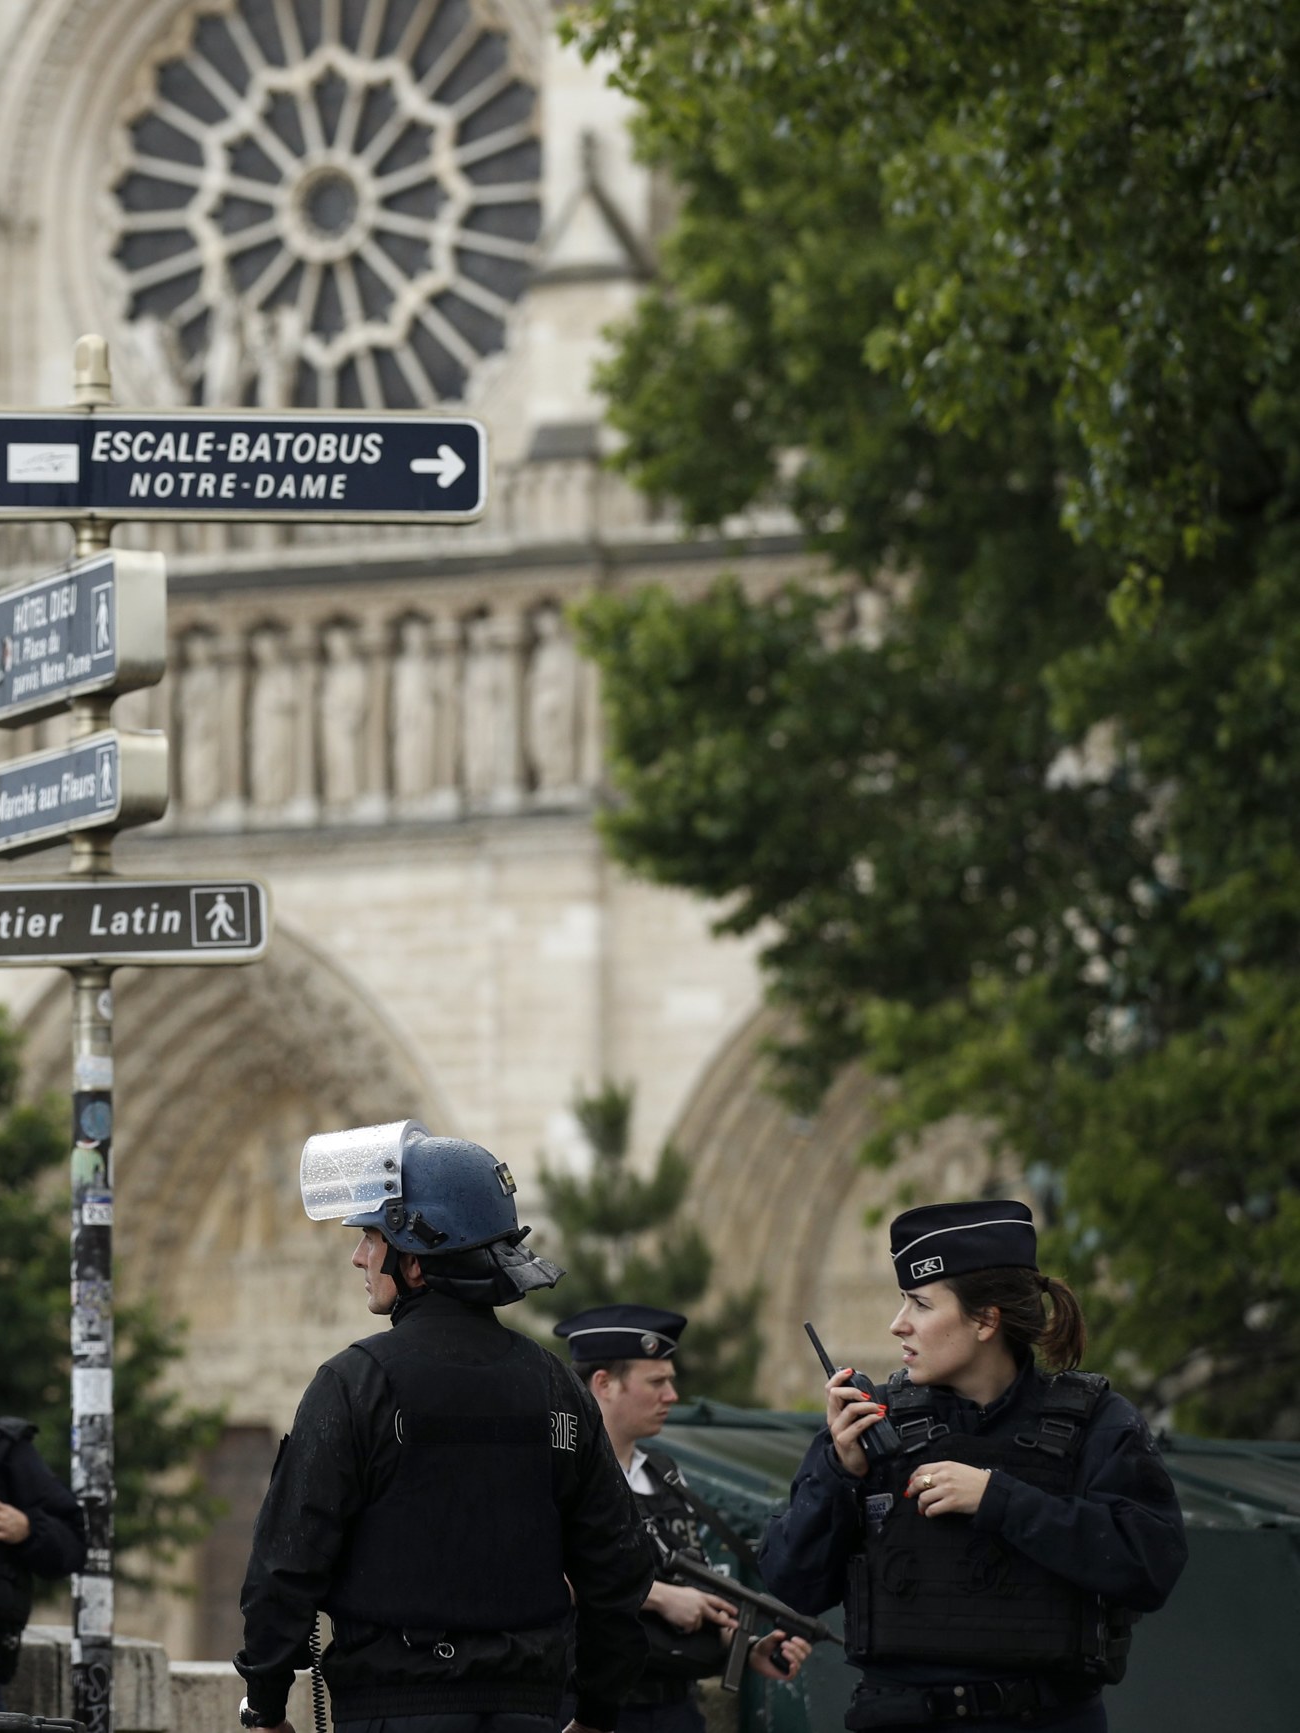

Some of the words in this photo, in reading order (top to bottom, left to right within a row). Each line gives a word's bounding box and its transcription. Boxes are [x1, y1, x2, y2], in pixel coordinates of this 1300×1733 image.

[91, 431, 383, 463] ESCALE-BATOBUS
[129, 472, 347, 499] NOTRE-DAME
[49, 583, 78, 623] DIEU
[37, 784, 60, 811] aux
[90, 903, 182, 936] Latin
